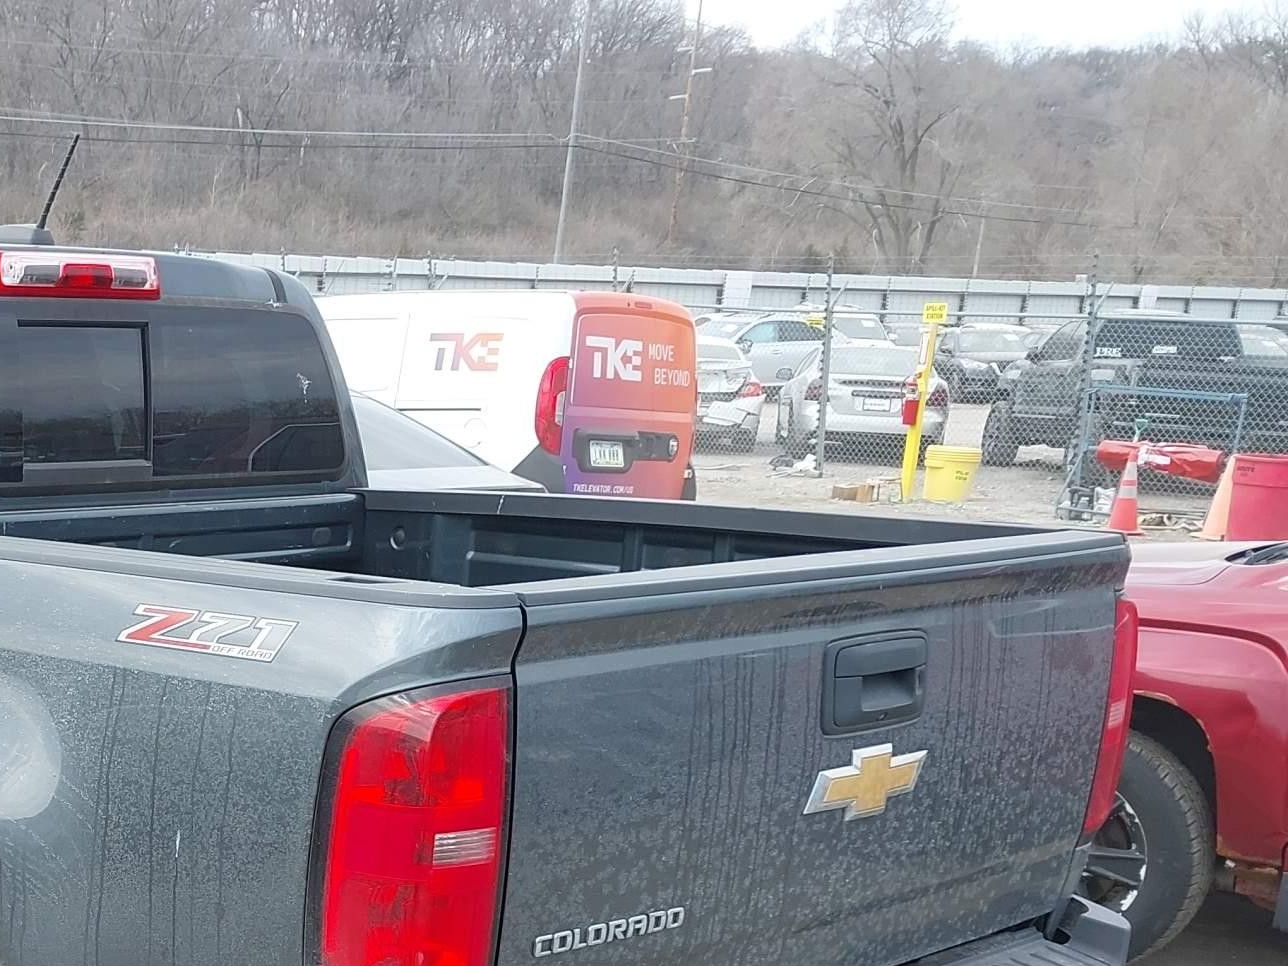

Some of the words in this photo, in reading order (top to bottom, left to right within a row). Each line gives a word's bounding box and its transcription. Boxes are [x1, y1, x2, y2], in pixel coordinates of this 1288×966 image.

[429, 332, 504, 371] TKE
[585, 335, 643, 382] TKE
[648, 342, 675, 362] MOVE
[654, 367, 690, 387] BEYOND
[115, 602, 300, 663] Z71
[211, 644, 235, 655] OFF
[237, 647, 273, 660] ROAD
[532, 906, 686, 958] COLORADO
